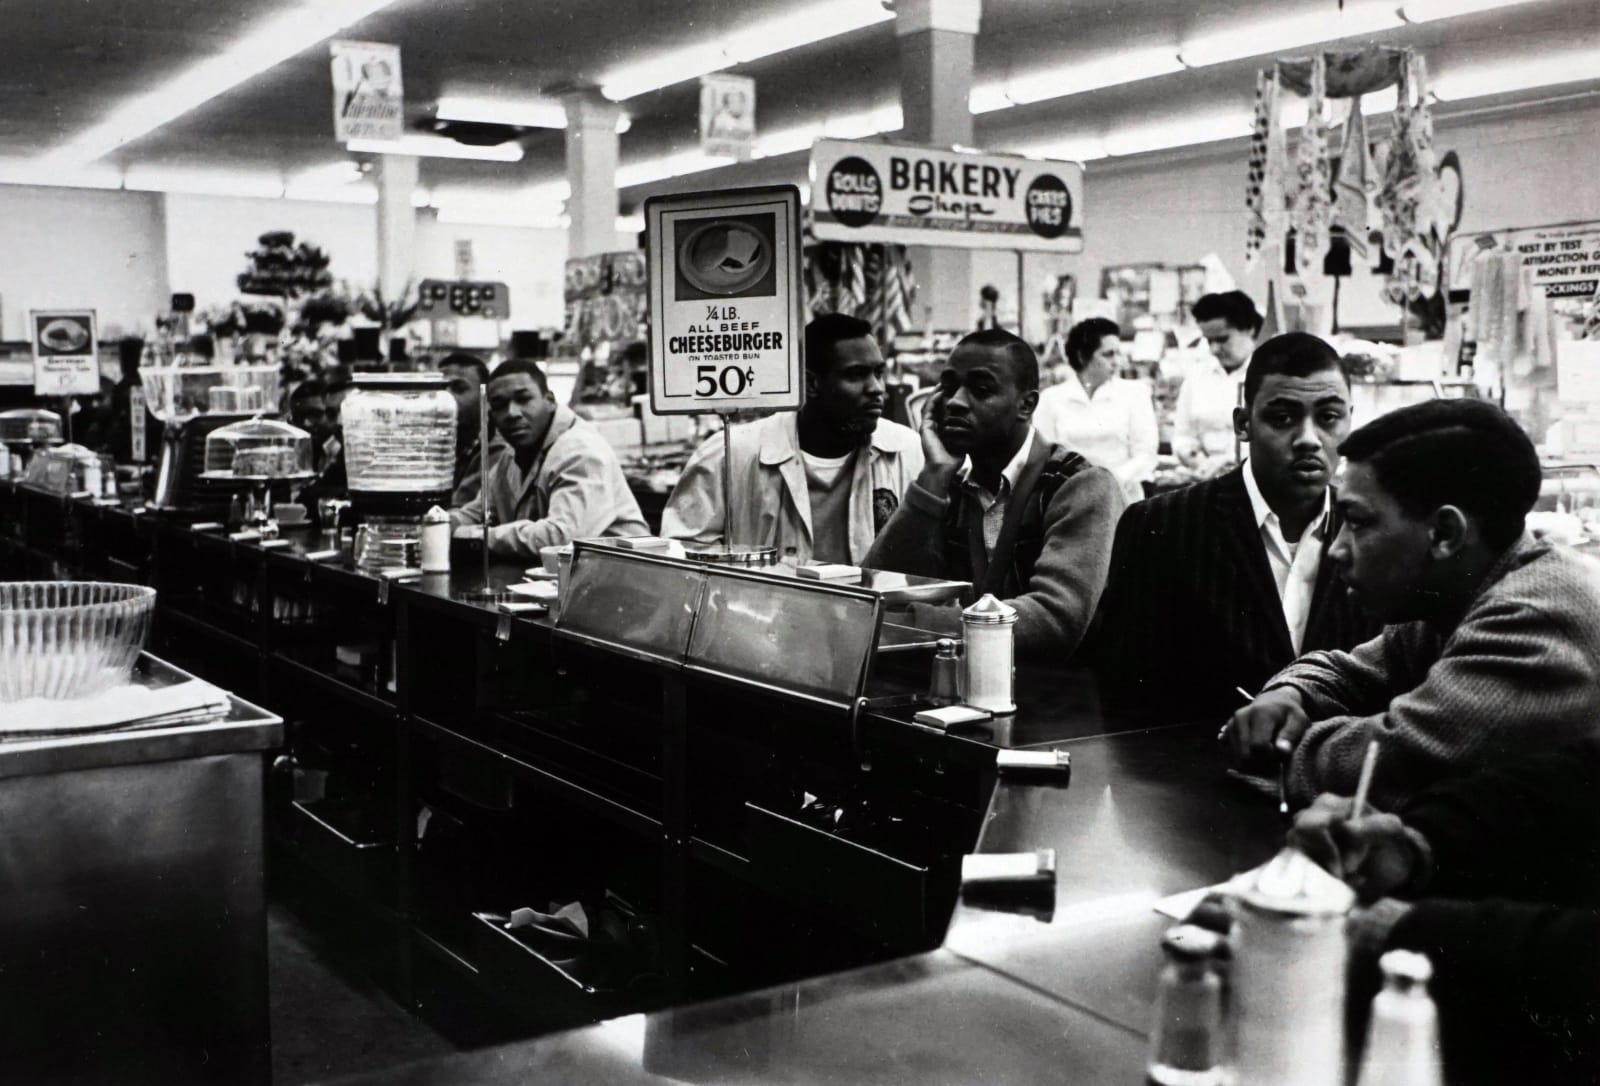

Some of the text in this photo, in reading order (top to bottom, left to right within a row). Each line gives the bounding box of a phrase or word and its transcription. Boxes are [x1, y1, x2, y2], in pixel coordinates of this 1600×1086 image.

[832, 171, 878, 192] ROLLS
[891, 157, 1021, 199] BAKERY
[1544, 242, 1557, 252] BY
[1560, 240, 1582, 251] TEST
[1522, 252, 1589, 265] ATISFACTION
[1536, 266, 1577, 277] MONEY
[1545, 282, 1594, 294] OCKINGS
[722, 306, 740, 320] LB.
[688, 321, 760, 333] ALL BEEF
[669, 332, 782, 354] CHEESEBURGER
[704, 353, 739, 361] TOASTED
[695, 365, 755, 397] 50¢
